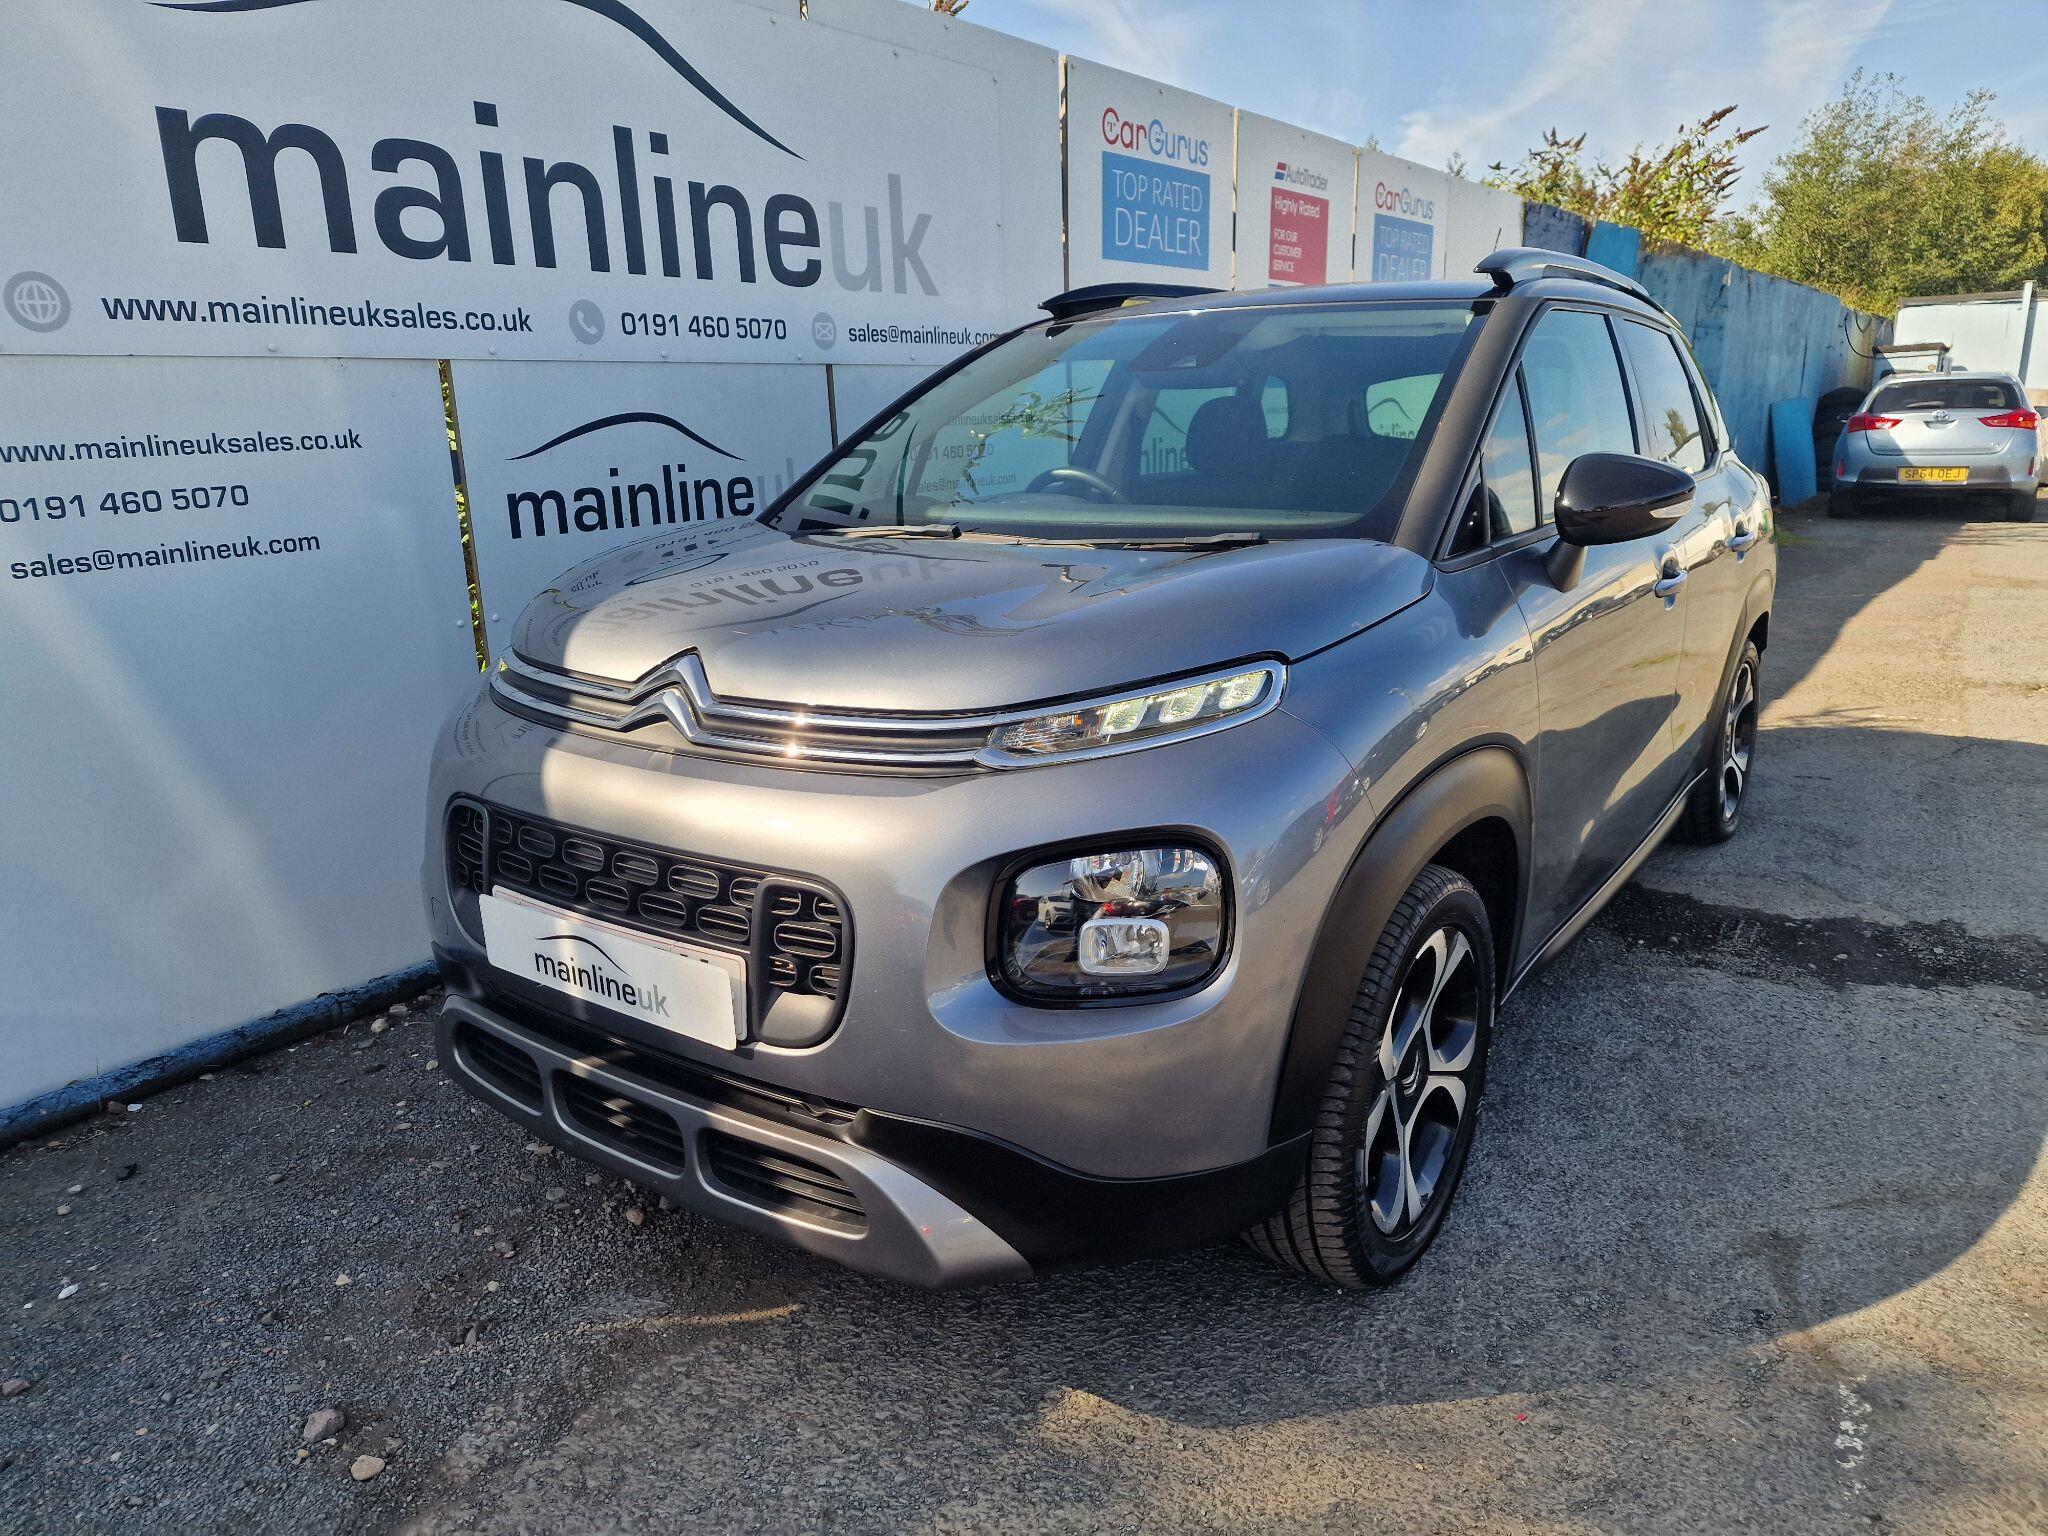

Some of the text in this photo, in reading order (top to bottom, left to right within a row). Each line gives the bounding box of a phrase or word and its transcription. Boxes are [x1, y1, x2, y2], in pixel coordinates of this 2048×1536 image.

[1102, 107, 1208, 166] CarGurus
[1112, 169, 1203, 213] TOP RATED
[1285, 164, 1328, 191] AutoTrader
[155, 100, 940, 297] mainlineuk
[1274, 195, 1320, 218] Highly Rated
[1375, 181, 1434, 220] CarGurus
[1115, 207, 1201, 257] DEALER
[1379, 225, 1428, 254] TOP RATED
[101, 296, 533, 333] www.mainlineuksales.co.uk
[621, 312, 787, 340] 0191 460 5070
[0, 484, 249, 523] 0191 460 5070
[10, 534, 321, 580] sales@mainlineuk.com
[534, 951, 670, 1018] mainlineuk
